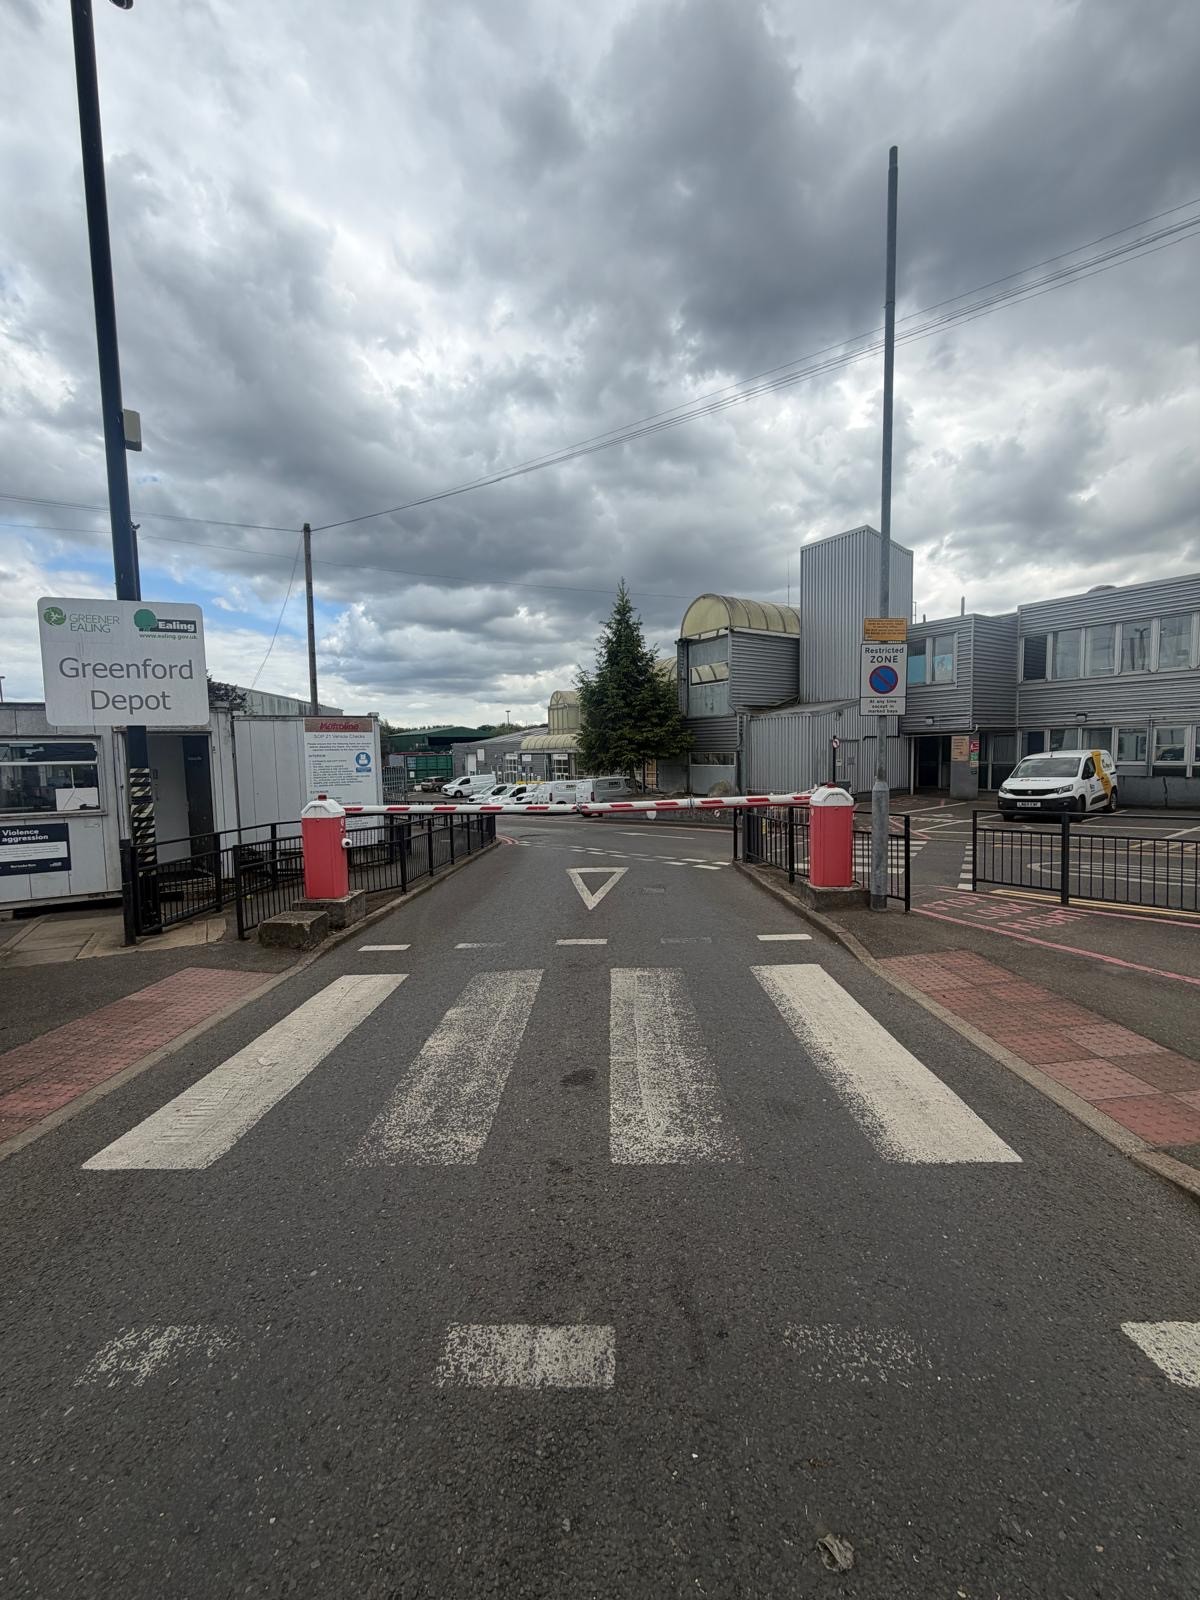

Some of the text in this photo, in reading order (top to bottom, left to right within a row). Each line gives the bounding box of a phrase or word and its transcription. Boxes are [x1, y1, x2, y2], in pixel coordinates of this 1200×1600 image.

[69, 613, 120, 625] GREENER
[70, 622, 111, 634] EALING
[158, 621, 196, 632] Ealing
[139, 633, 198, 641] www.ealing.gov.uk
[870, 655, 899, 664] ZONE
[59, 656, 193, 680] Greenford
[90, 689, 172, 715] Depot
[1, 834, 49, 843] aggression
[921, 895, 987, 911] STOP
[962, 902, 1038, 920] LOOK
[997, 909, 1089, 932] RIGHT
